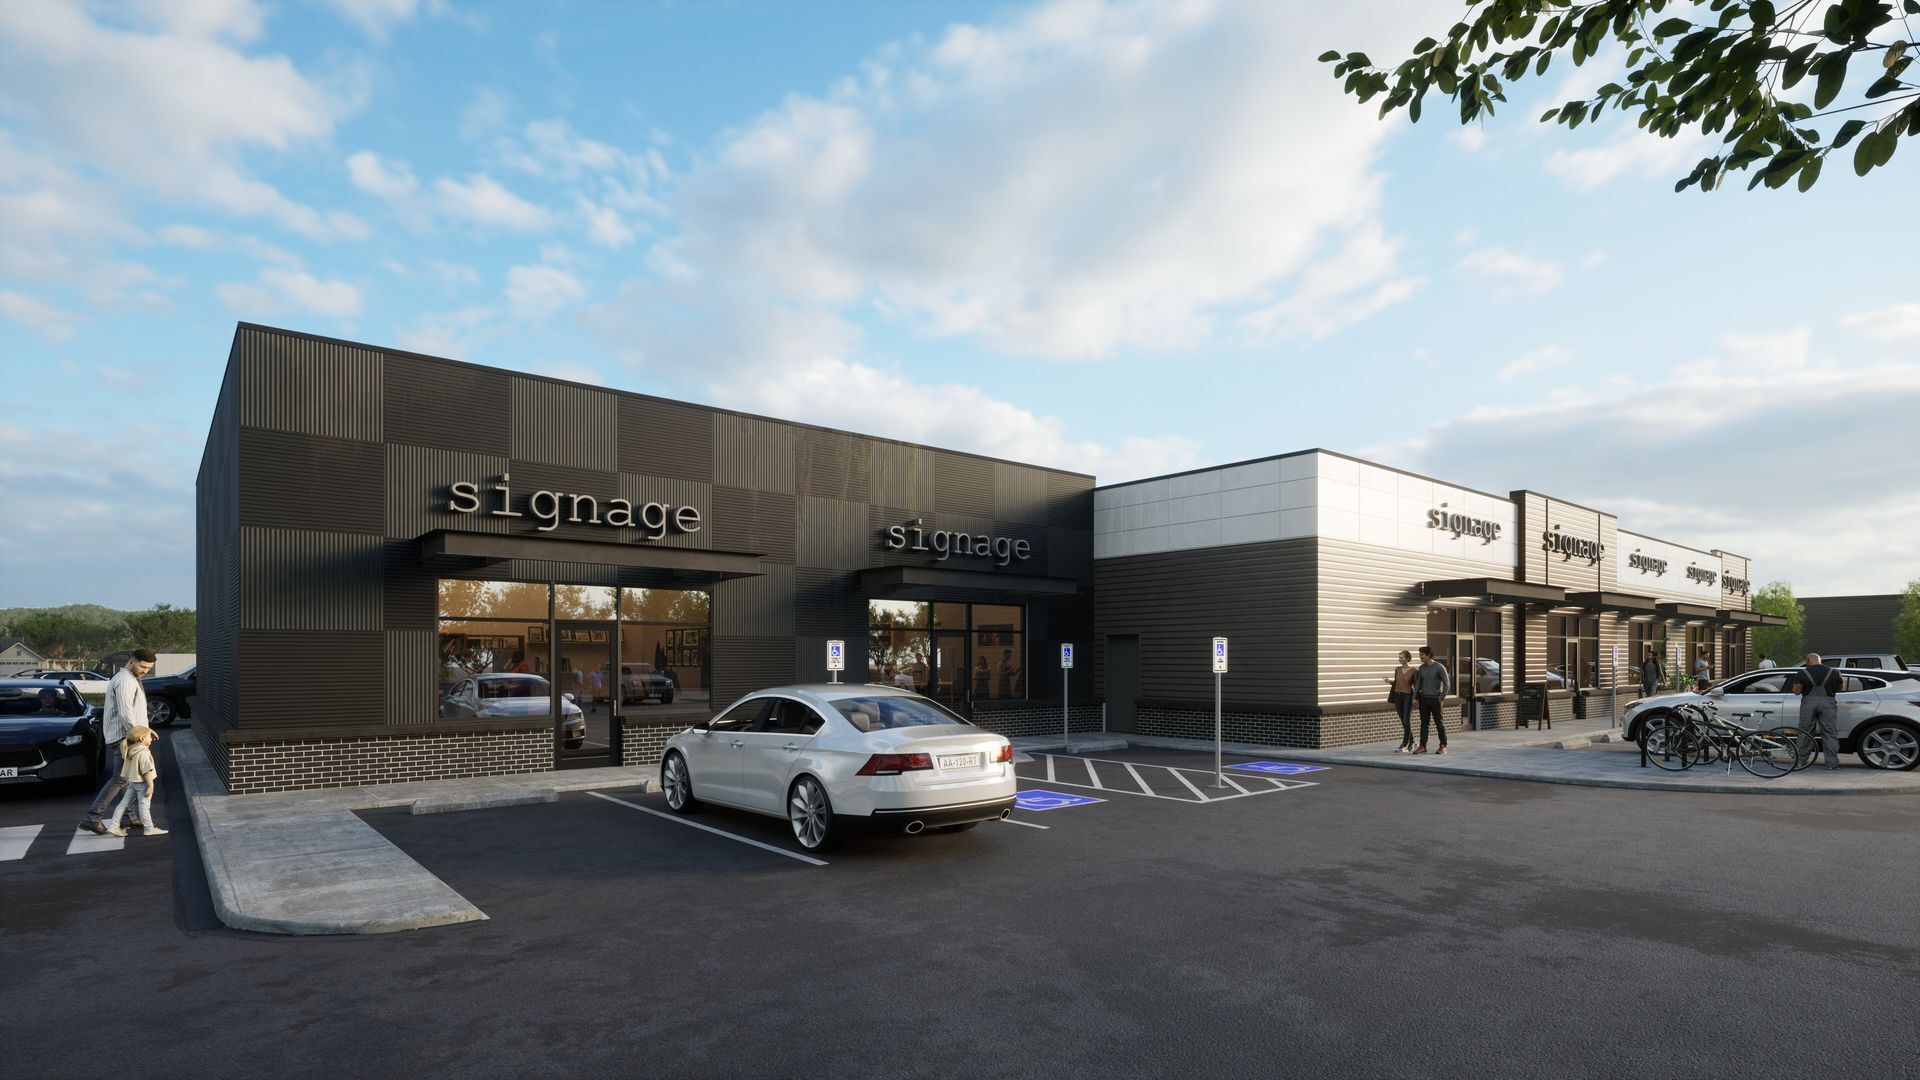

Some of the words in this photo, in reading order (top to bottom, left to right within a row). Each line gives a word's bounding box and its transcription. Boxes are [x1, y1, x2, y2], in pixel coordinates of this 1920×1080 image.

[449, 473, 701, 540] signage
[1426, 502, 1502, 545] signage
[886, 518, 1031, 565] signage
[1542, 524, 1605, 566] signage
[1628, 548, 1668, 577] signage
